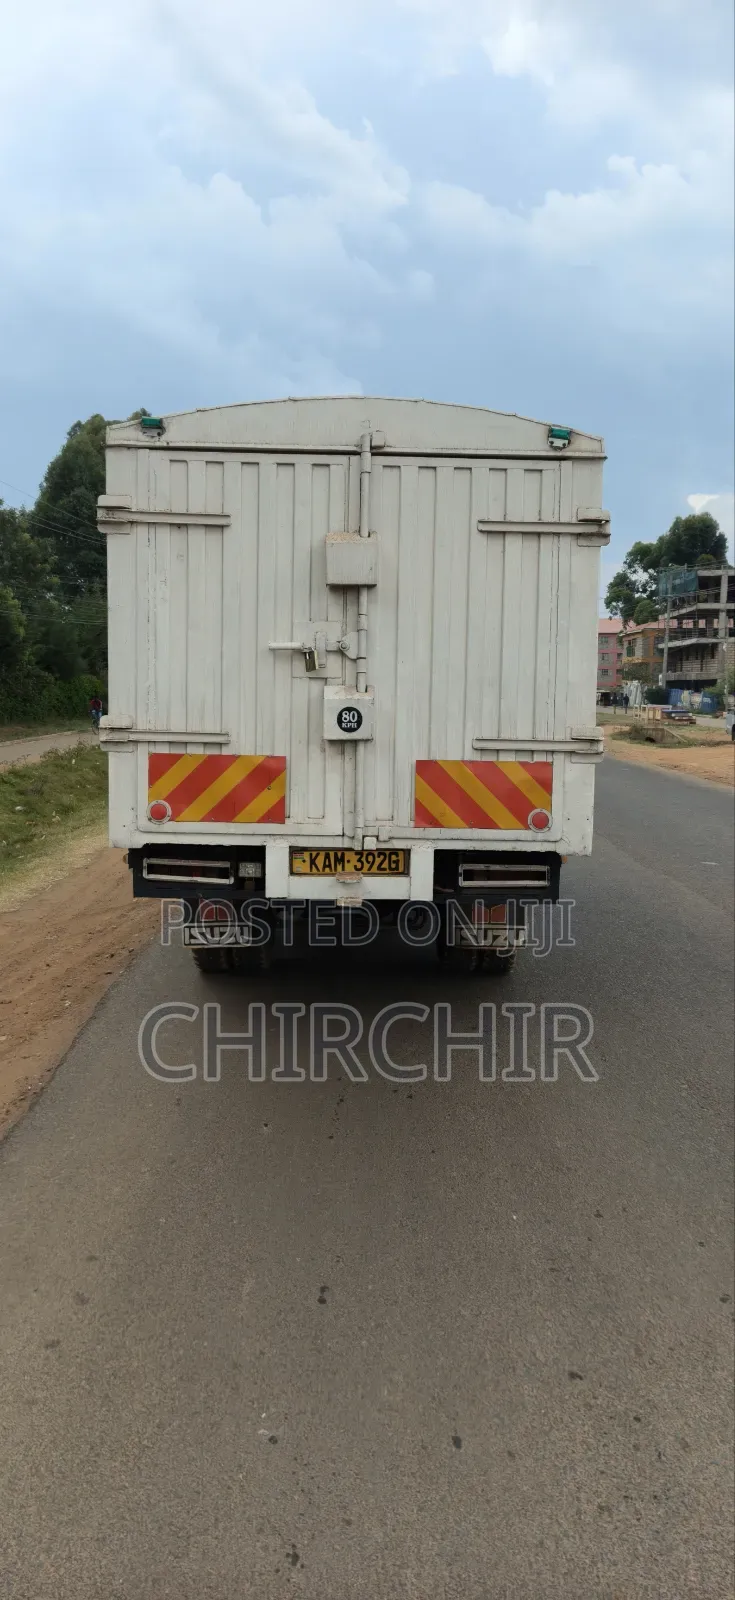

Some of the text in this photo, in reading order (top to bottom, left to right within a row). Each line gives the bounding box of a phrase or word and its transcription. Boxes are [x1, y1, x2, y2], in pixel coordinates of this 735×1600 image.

[341, 711, 358, 722] 80
[184, 926, 250, 945] ISUZU
[456, 929, 526, 946] ISUZU
